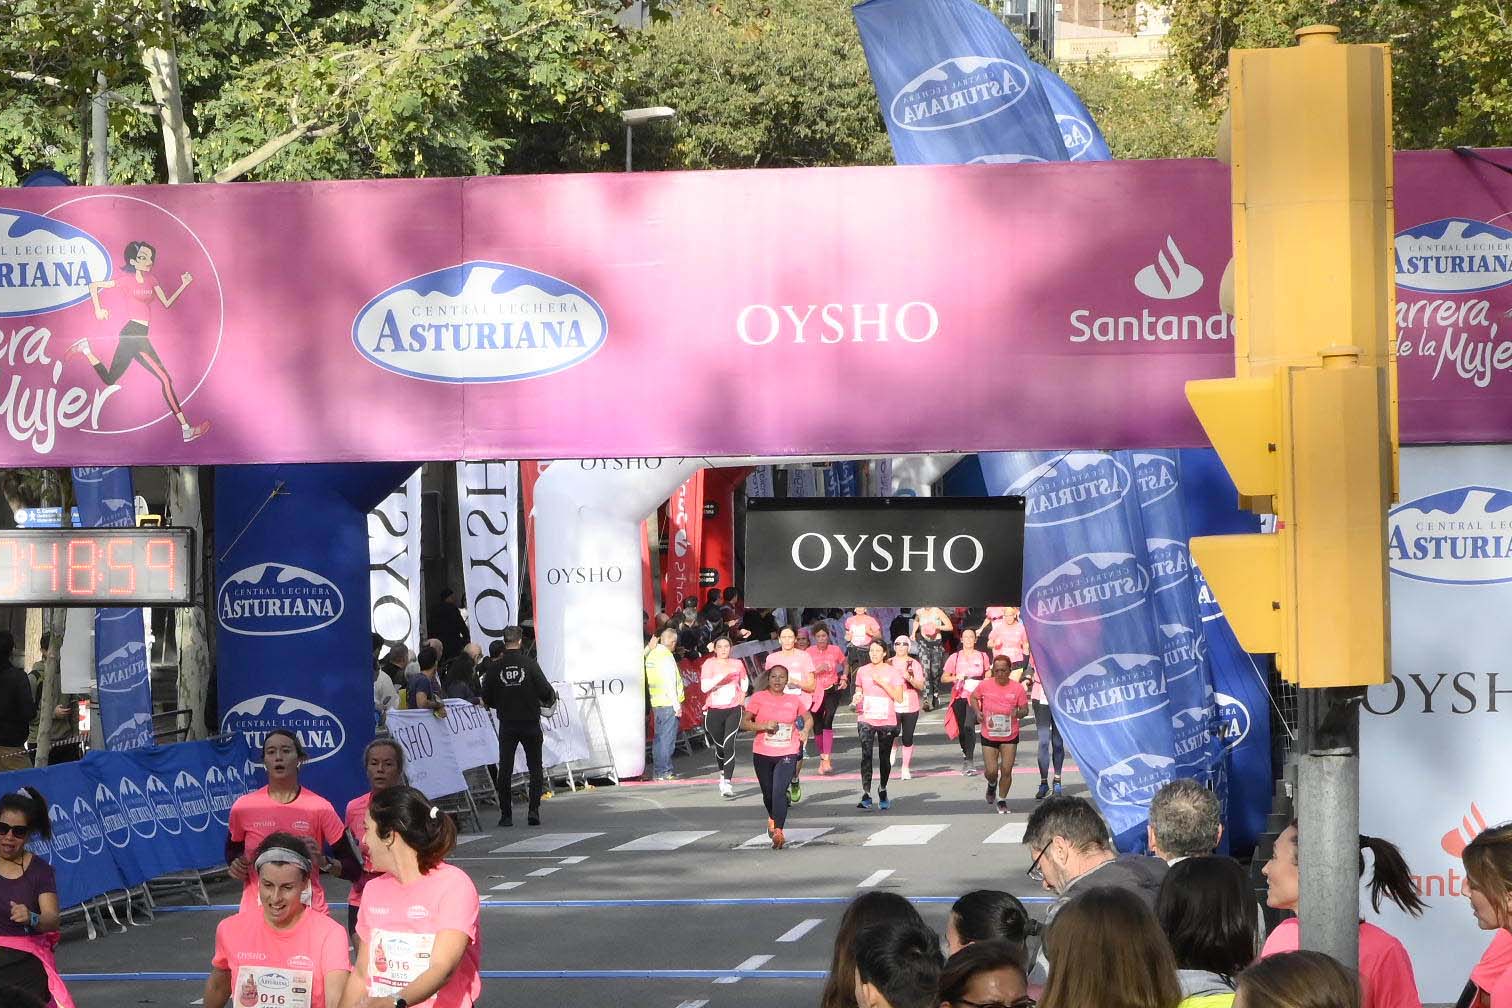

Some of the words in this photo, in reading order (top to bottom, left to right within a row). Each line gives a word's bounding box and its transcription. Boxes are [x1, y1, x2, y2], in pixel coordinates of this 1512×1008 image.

[15, 244, 88, 256] LECHERA
[1465, 242, 1512, 252] LECHER
[735, 300, 941, 346] OYSHO
[1069, 308, 1238, 343] Santand
[1396, 299, 1490, 328] arrera
[372, 308, 589, 353] ASTURIANA
[1418, 328, 1437, 356] la
[1432, 326, 1512, 388] Muje
[1415, 520, 1482, 532] CENTRAL
[790, 531, 984, 575] OYSHO
[547, 565, 622, 585] OYSHO
[234, 588, 276, 596] CENTRAL
[281, 587, 330, 596] LECHERA
[222, 592, 335, 620] ASTURIANA
[235, 719, 276, 728] CENTRAL
[282, 719, 331, 728] LECHERA
[260, 993, 286, 1005] 016
